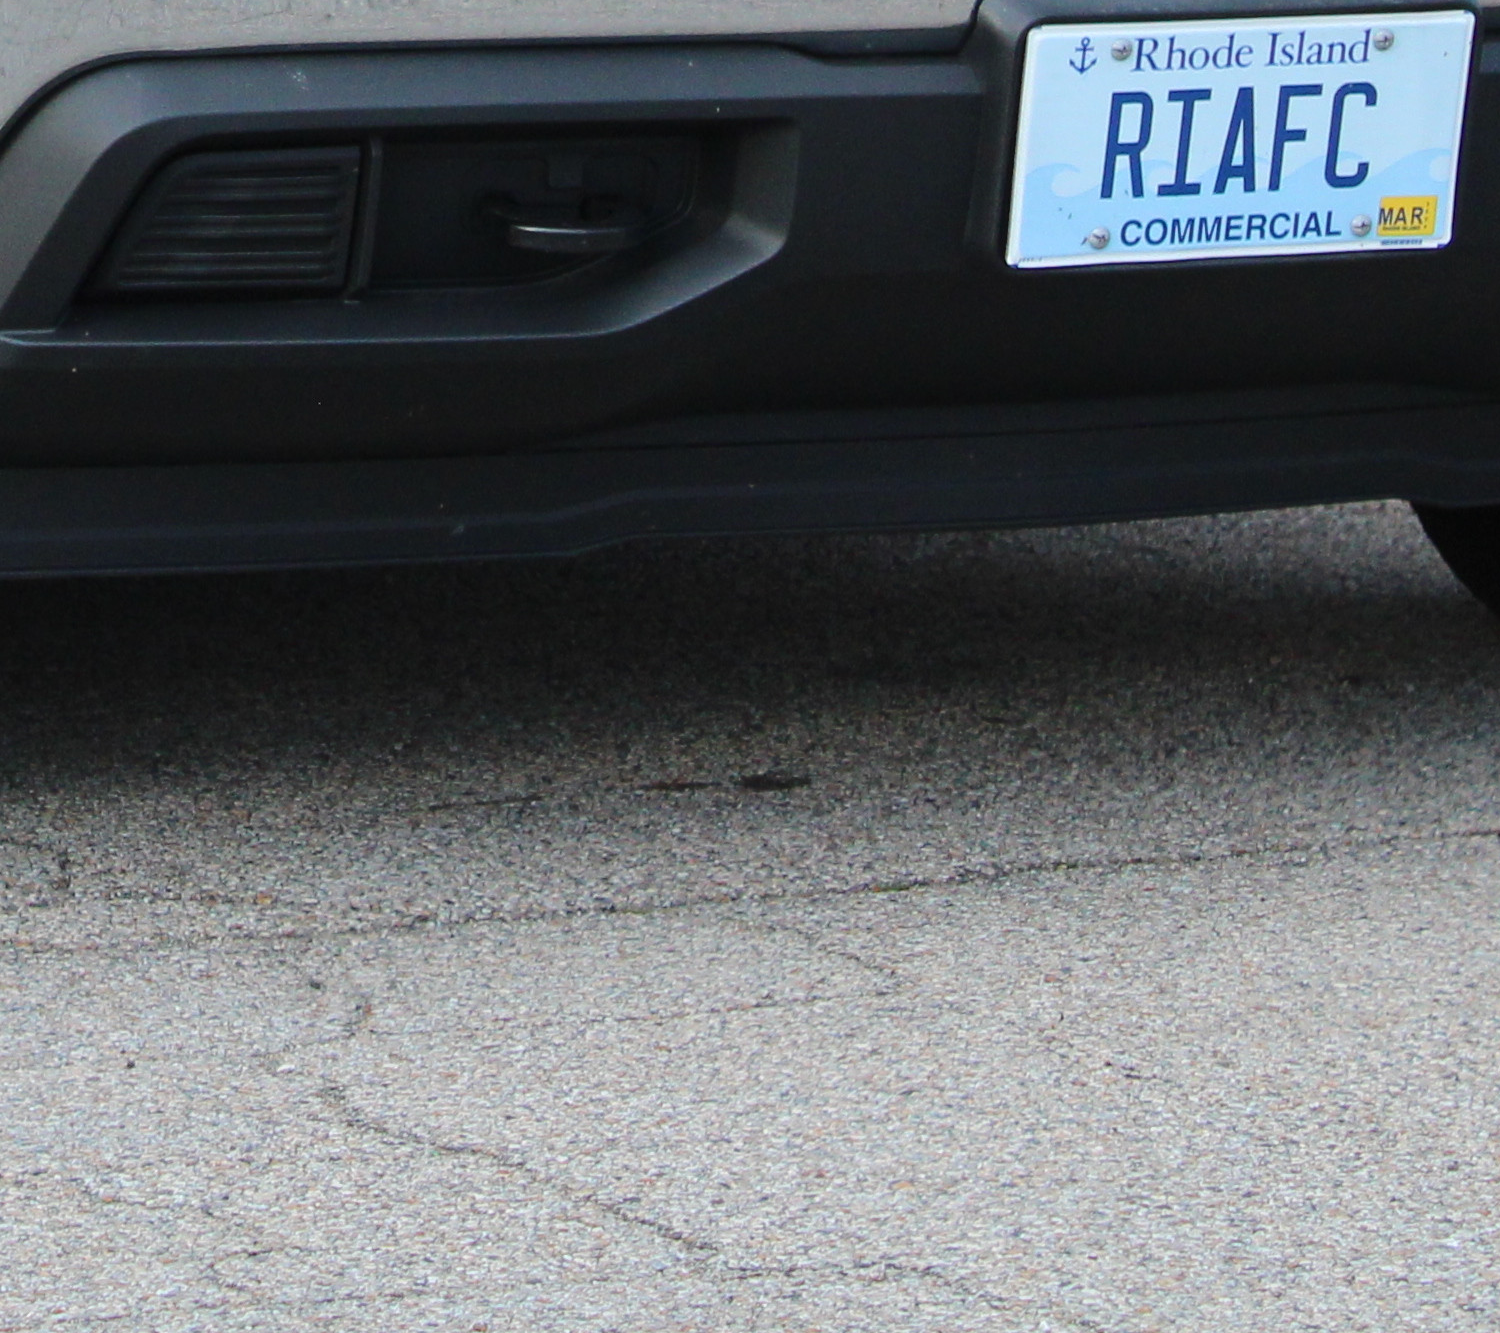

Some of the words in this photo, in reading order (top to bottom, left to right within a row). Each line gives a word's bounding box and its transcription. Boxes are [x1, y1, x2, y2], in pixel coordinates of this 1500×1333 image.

[1131, 33, 1255, 73] Rhode
[1265, 29, 1372, 68] Island
[1099, 81, 1378, 200] RIAFC
[1120, 211, 1342, 248] COMMERCIAL
[1378, 206, 1424, 226] MAR
